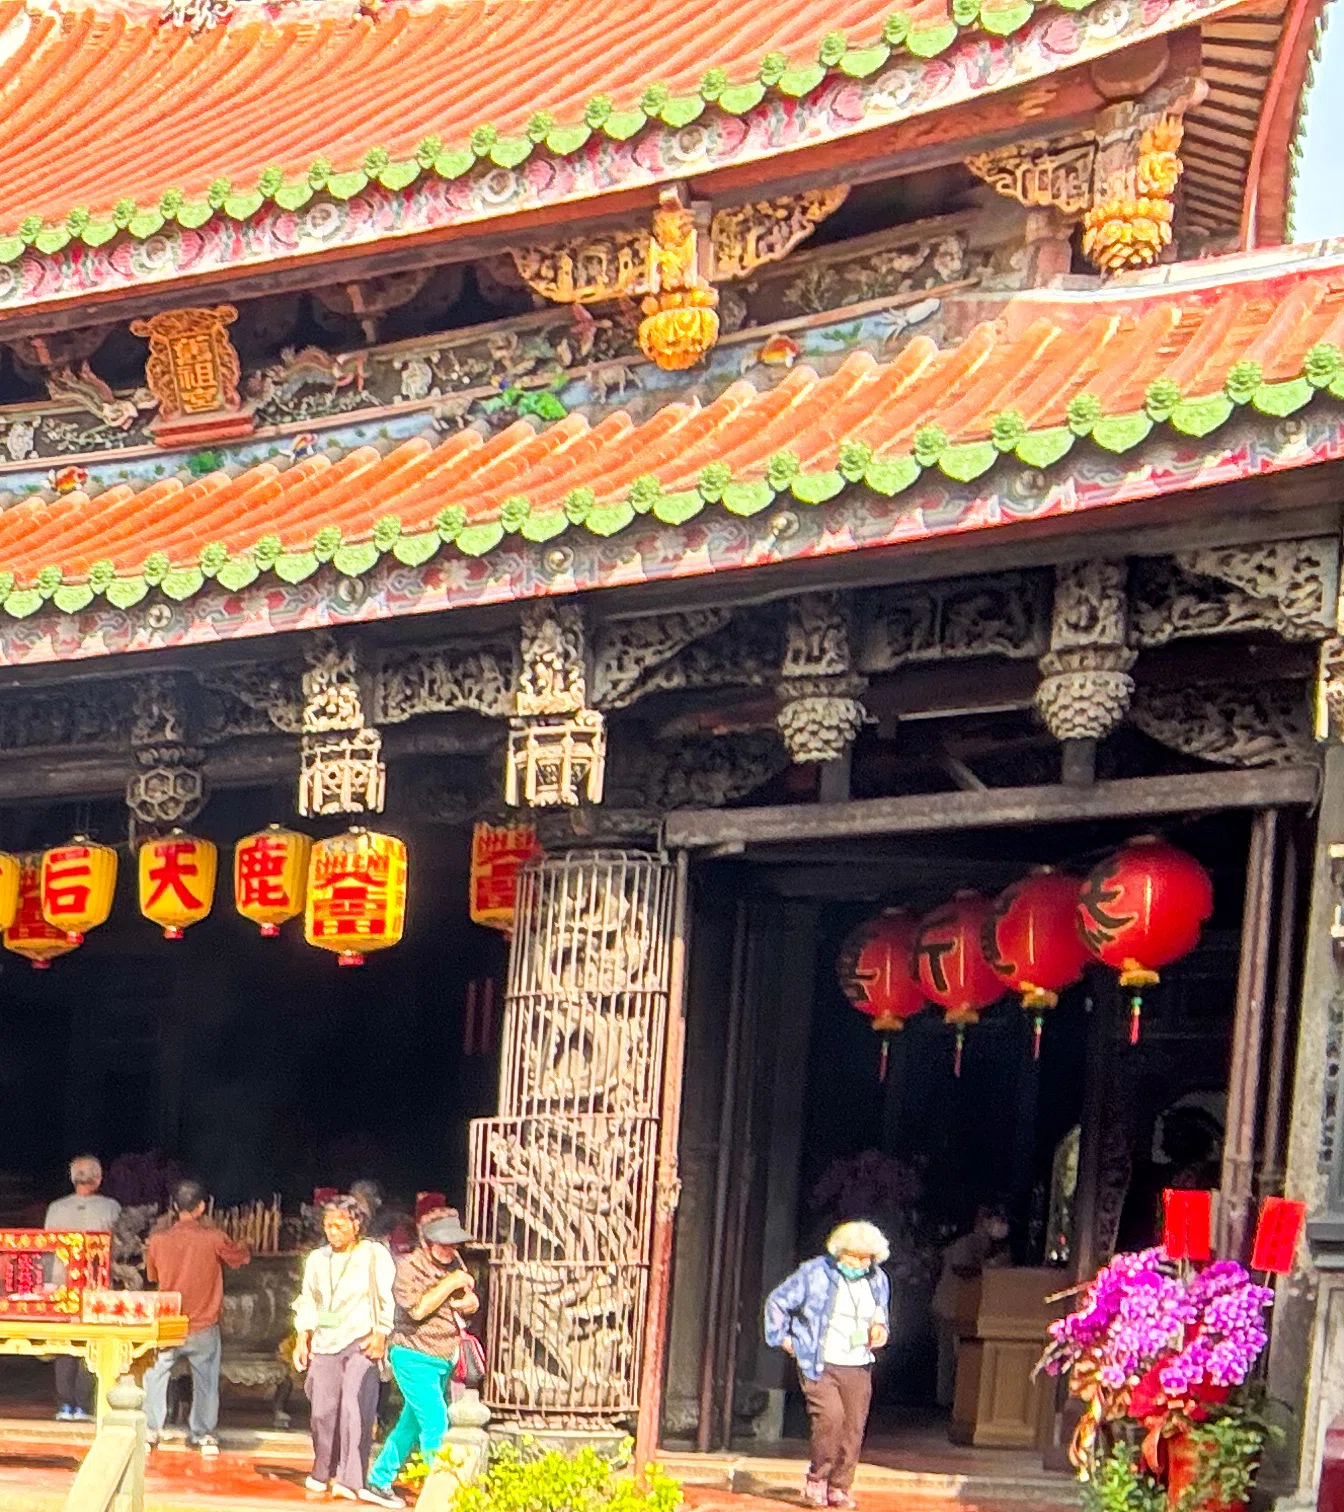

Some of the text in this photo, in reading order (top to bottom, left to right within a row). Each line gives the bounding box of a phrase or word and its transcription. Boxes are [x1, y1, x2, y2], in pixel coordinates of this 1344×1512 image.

[44, 846, 91, 915] 后
[146, 842, 203, 910] 天
[239, 836, 290, 908] 鹿
